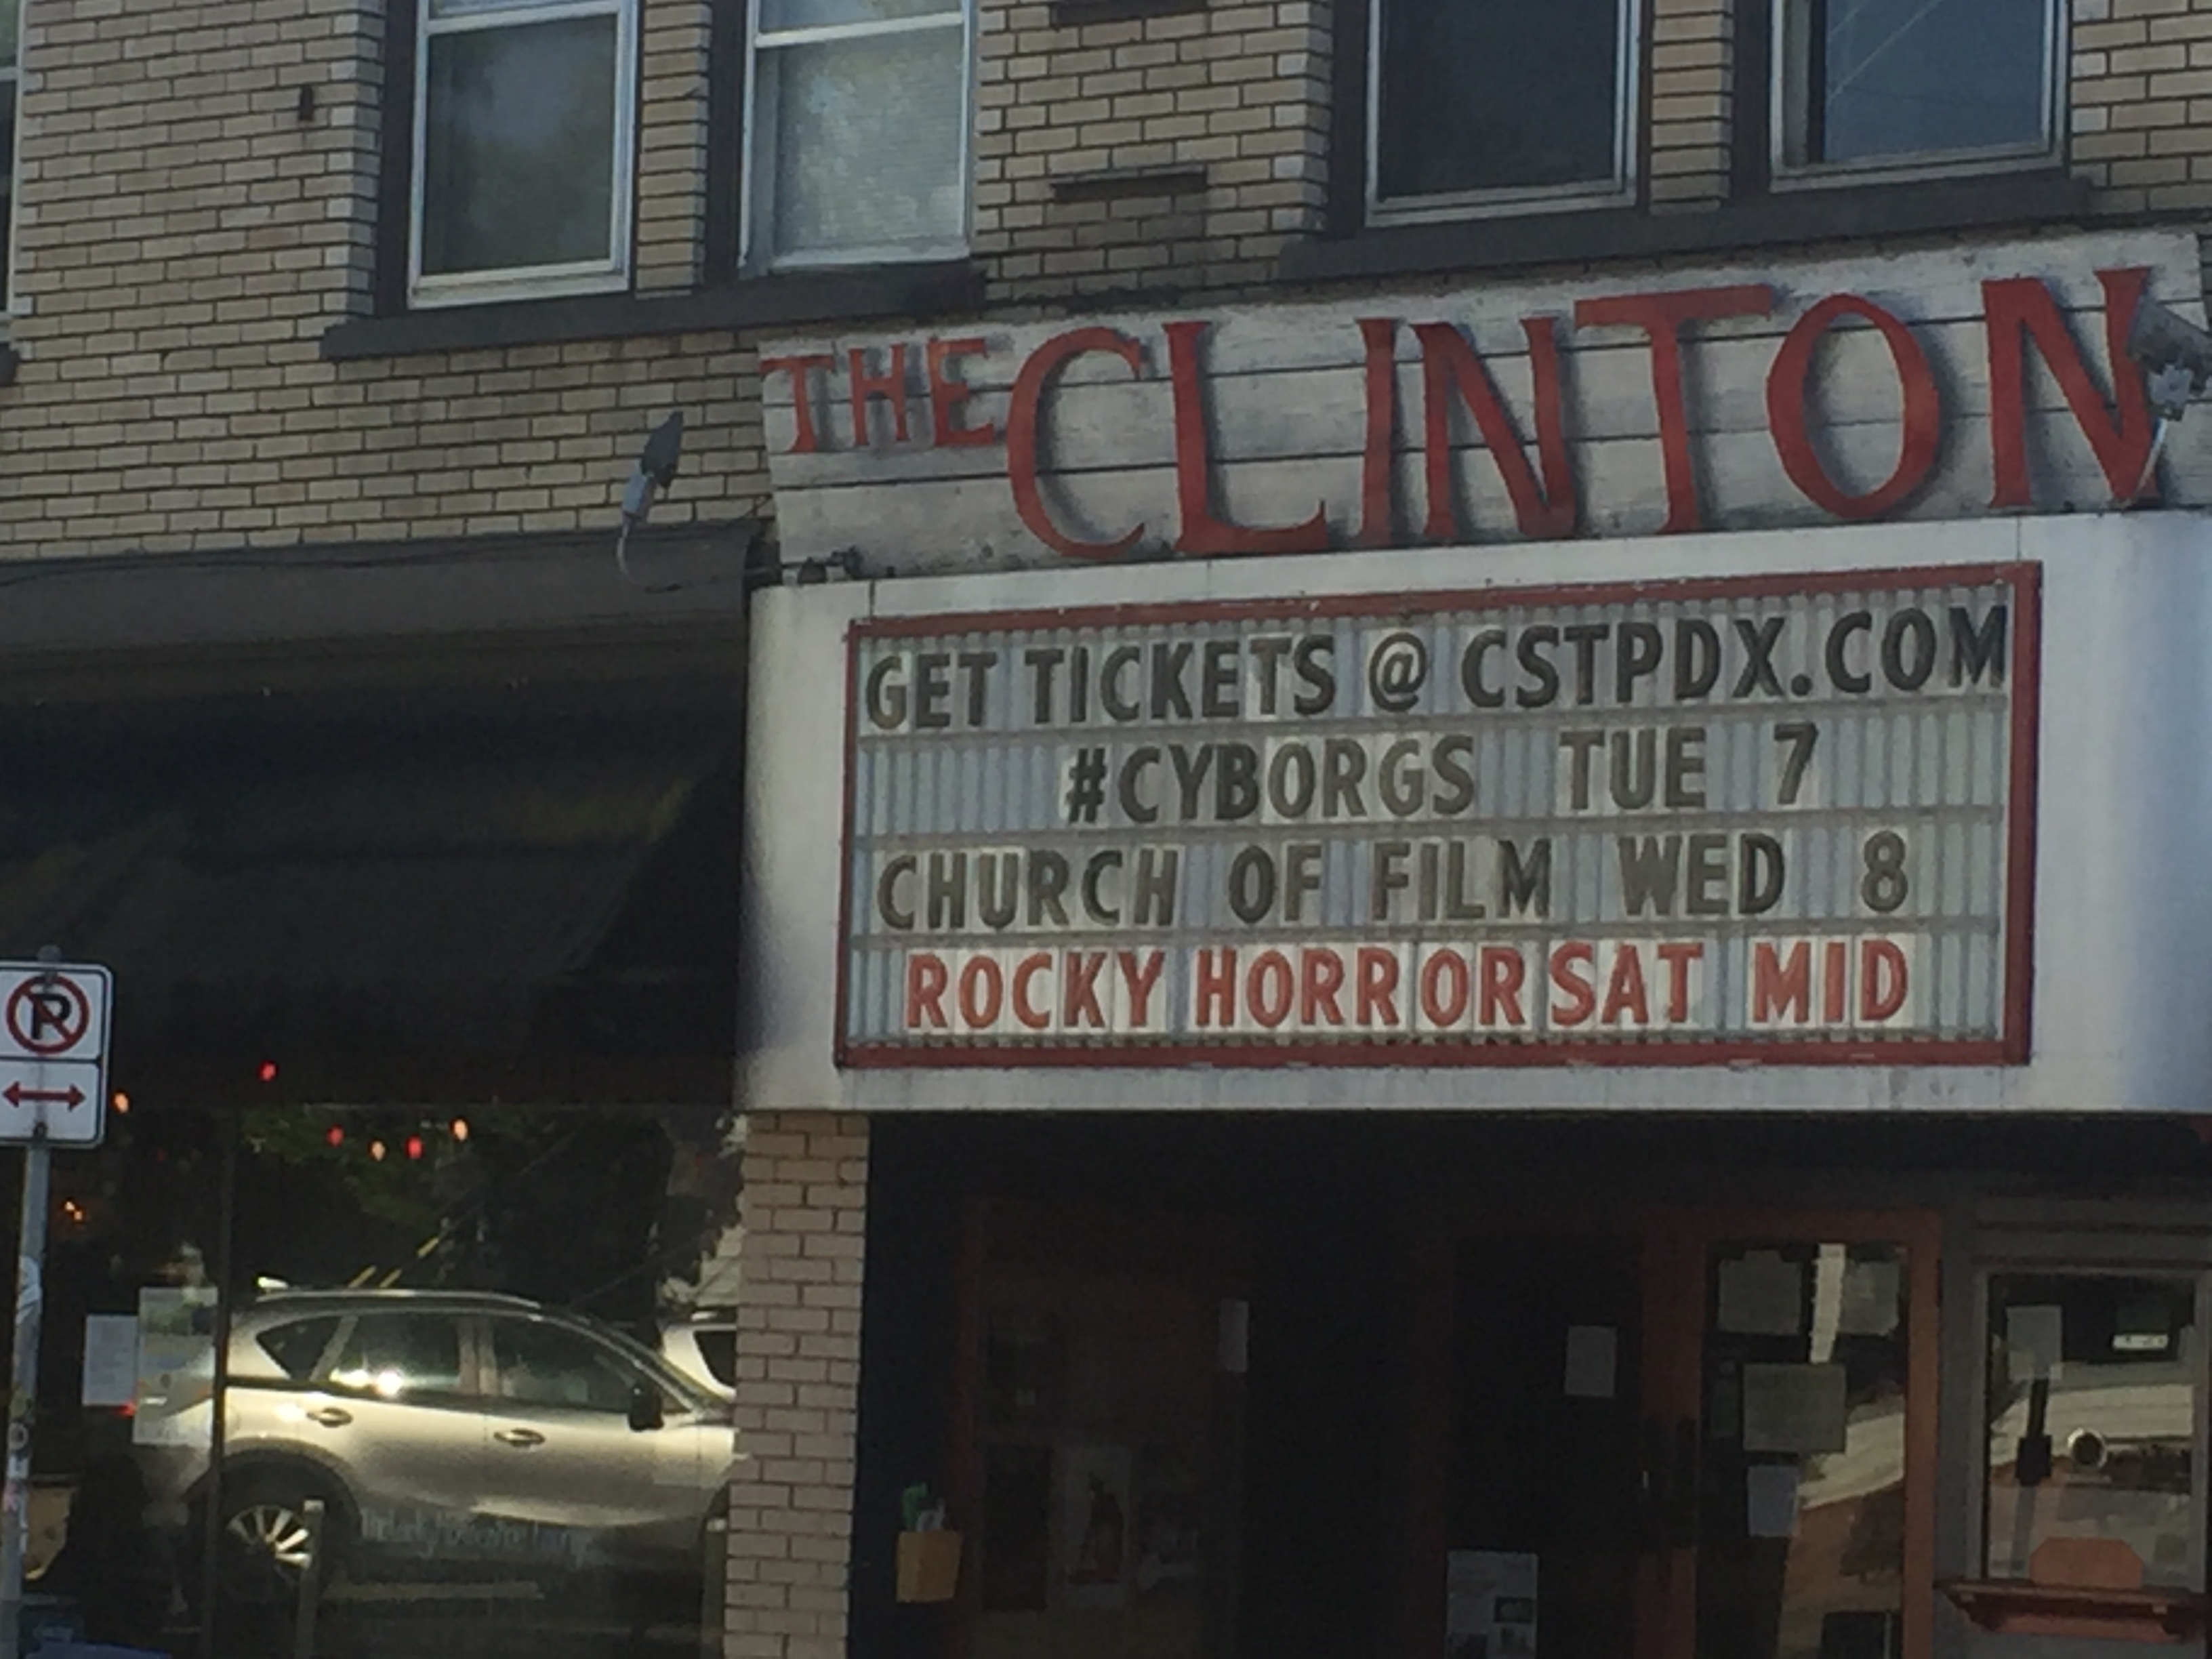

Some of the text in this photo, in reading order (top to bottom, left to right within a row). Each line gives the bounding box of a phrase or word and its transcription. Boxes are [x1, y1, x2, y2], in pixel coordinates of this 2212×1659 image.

[759, 266, 2160, 560] THE CLINTON
[865, 605, 2008, 730] GET TICKETS @ CSTPDX.COM
[1066, 721, 1820, 825] #CYBORGS TUE 7
[876, 830, 1909, 930] CHURCH OF FILM WED 8
[906, 939, 1910, 1030] ROCKY HORROR SAT MID
